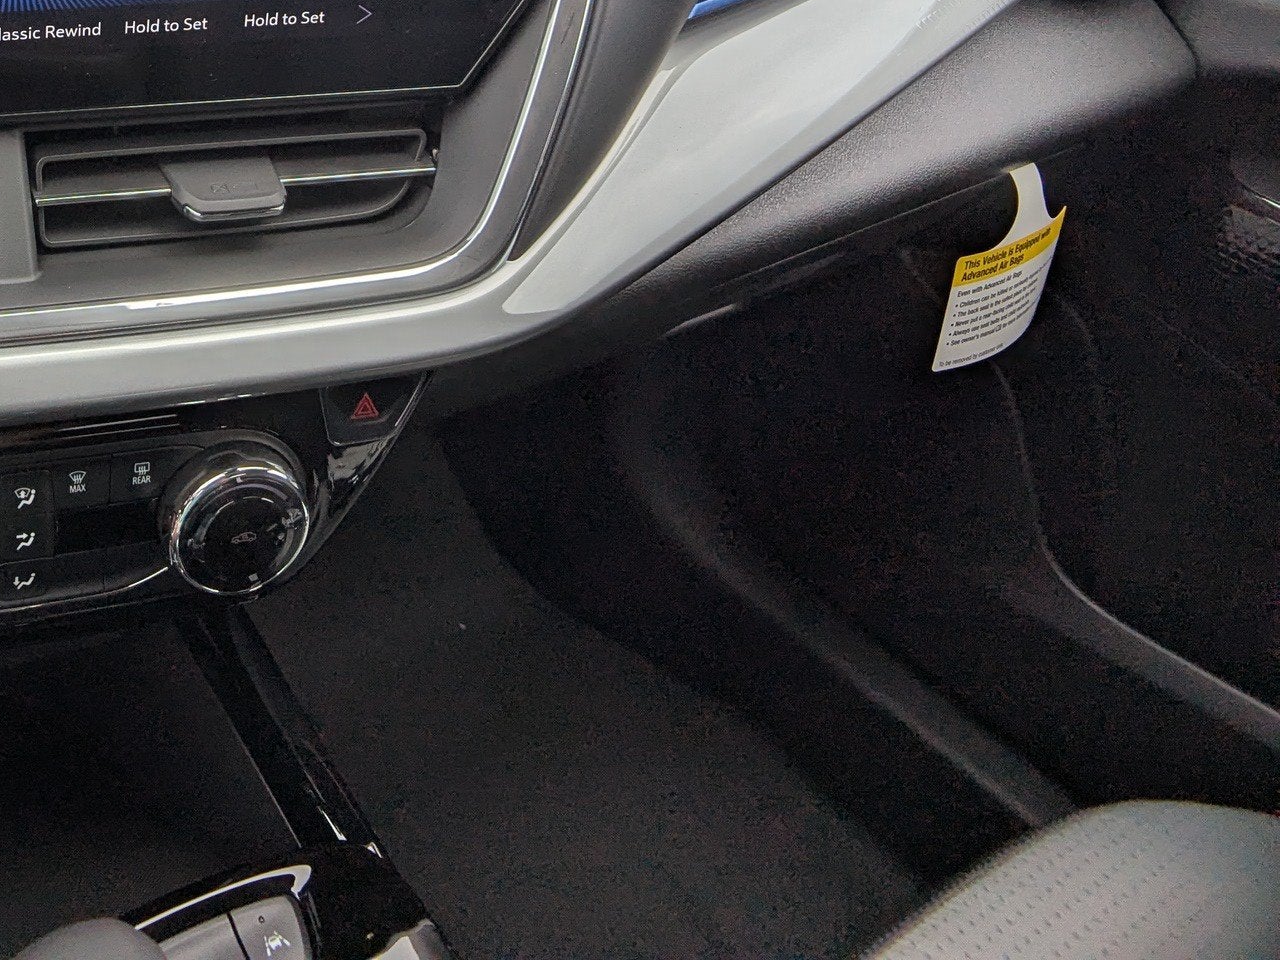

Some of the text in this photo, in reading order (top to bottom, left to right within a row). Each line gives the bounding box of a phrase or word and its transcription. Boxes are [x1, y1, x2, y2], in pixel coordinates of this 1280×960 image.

[124, 17, 208, 35] Hold to Set
[243, 11, 325, 28] Hold to Set
[45, 22, 102, 39] Rewind
[964, 259, 981, 270] This
[983, 250, 1007, 265] Vehicle
[1008, 246, 1014, 255] is
[1015, 234, 1041, 253] Equipped
[961, 253, 1025, 282] Advanced Air Bags
[69, 483, 86, 493] MAX
[132, 475, 151, 485] REAR
